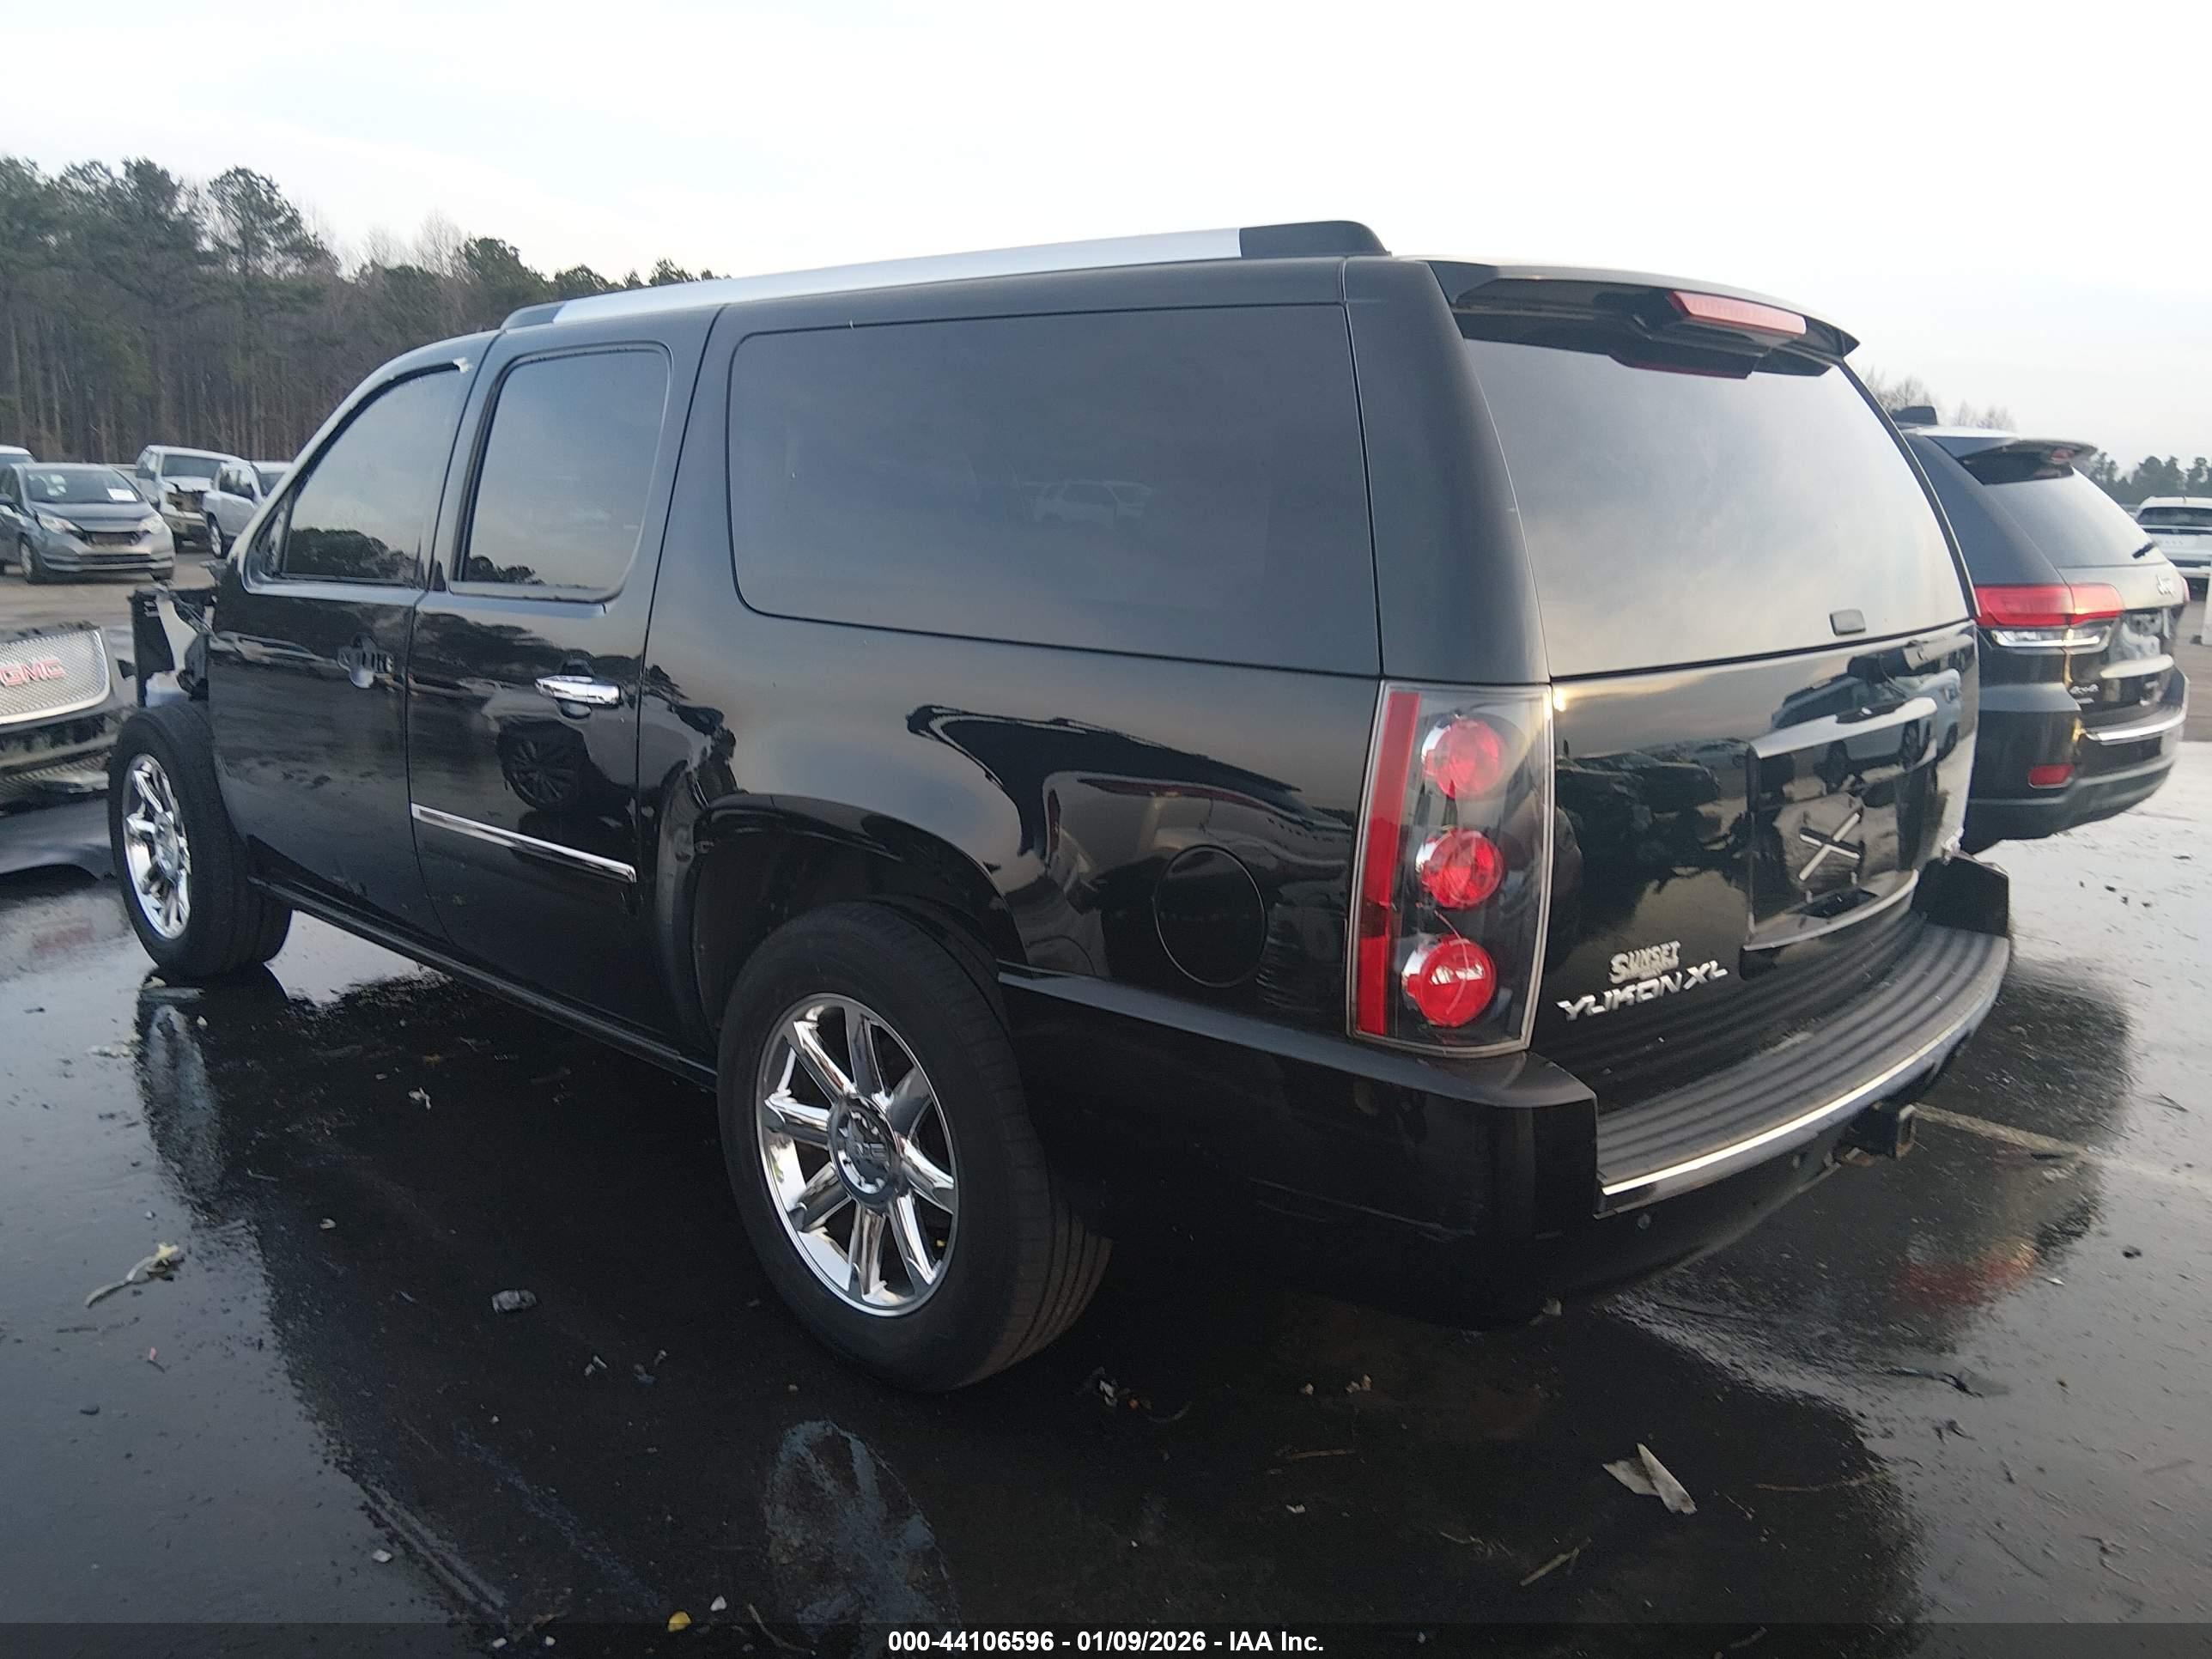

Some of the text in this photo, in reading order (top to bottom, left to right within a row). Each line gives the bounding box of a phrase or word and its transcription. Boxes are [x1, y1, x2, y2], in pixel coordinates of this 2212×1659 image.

[0, 659, 69, 687] GMC
[1608, 940, 1680, 984] SUNSET
[1555, 971, 1683, 1021] YUKON
[1683, 959, 1729, 990] XL
